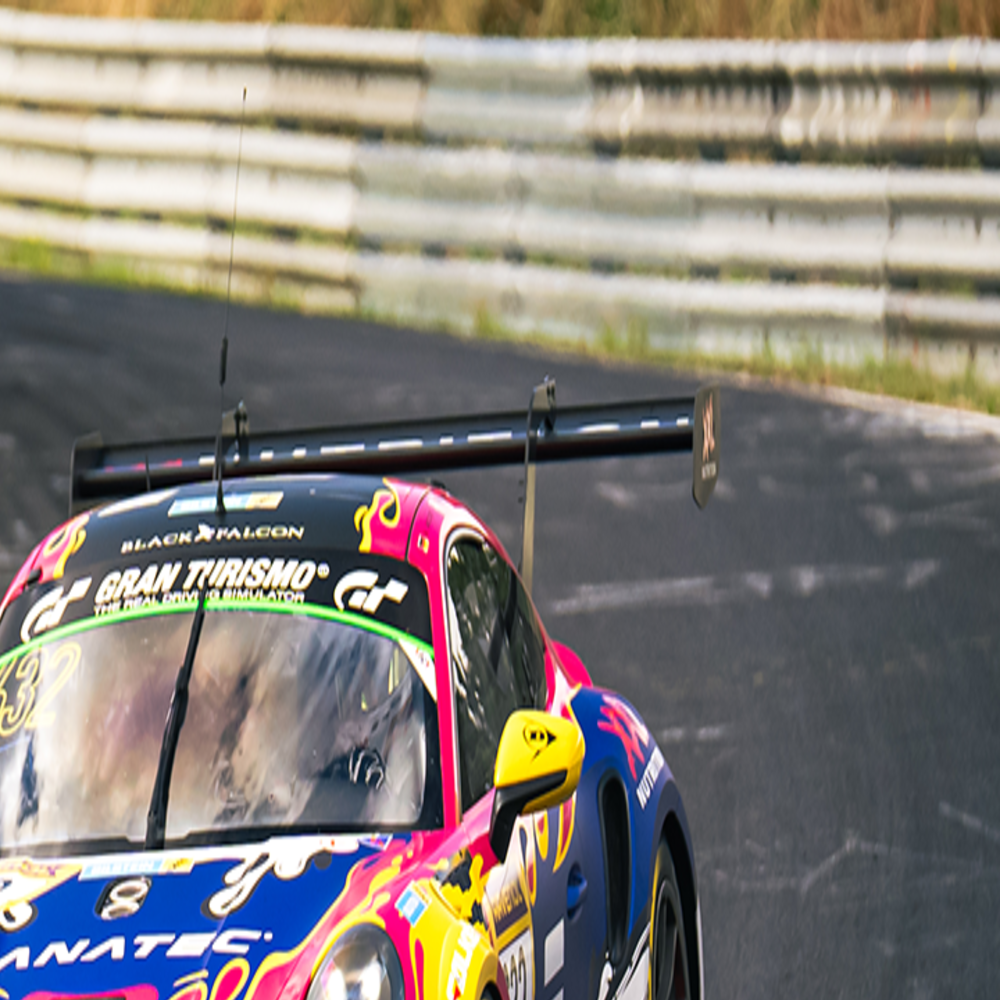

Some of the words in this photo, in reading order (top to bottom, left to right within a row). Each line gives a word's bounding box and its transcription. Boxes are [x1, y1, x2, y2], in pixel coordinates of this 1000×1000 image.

[120, 529, 193, 555] BLACK
[216, 525, 305, 541] FALCON
[95, 560, 182, 604] GRAN
[182, 556, 317, 590] TURISMO
